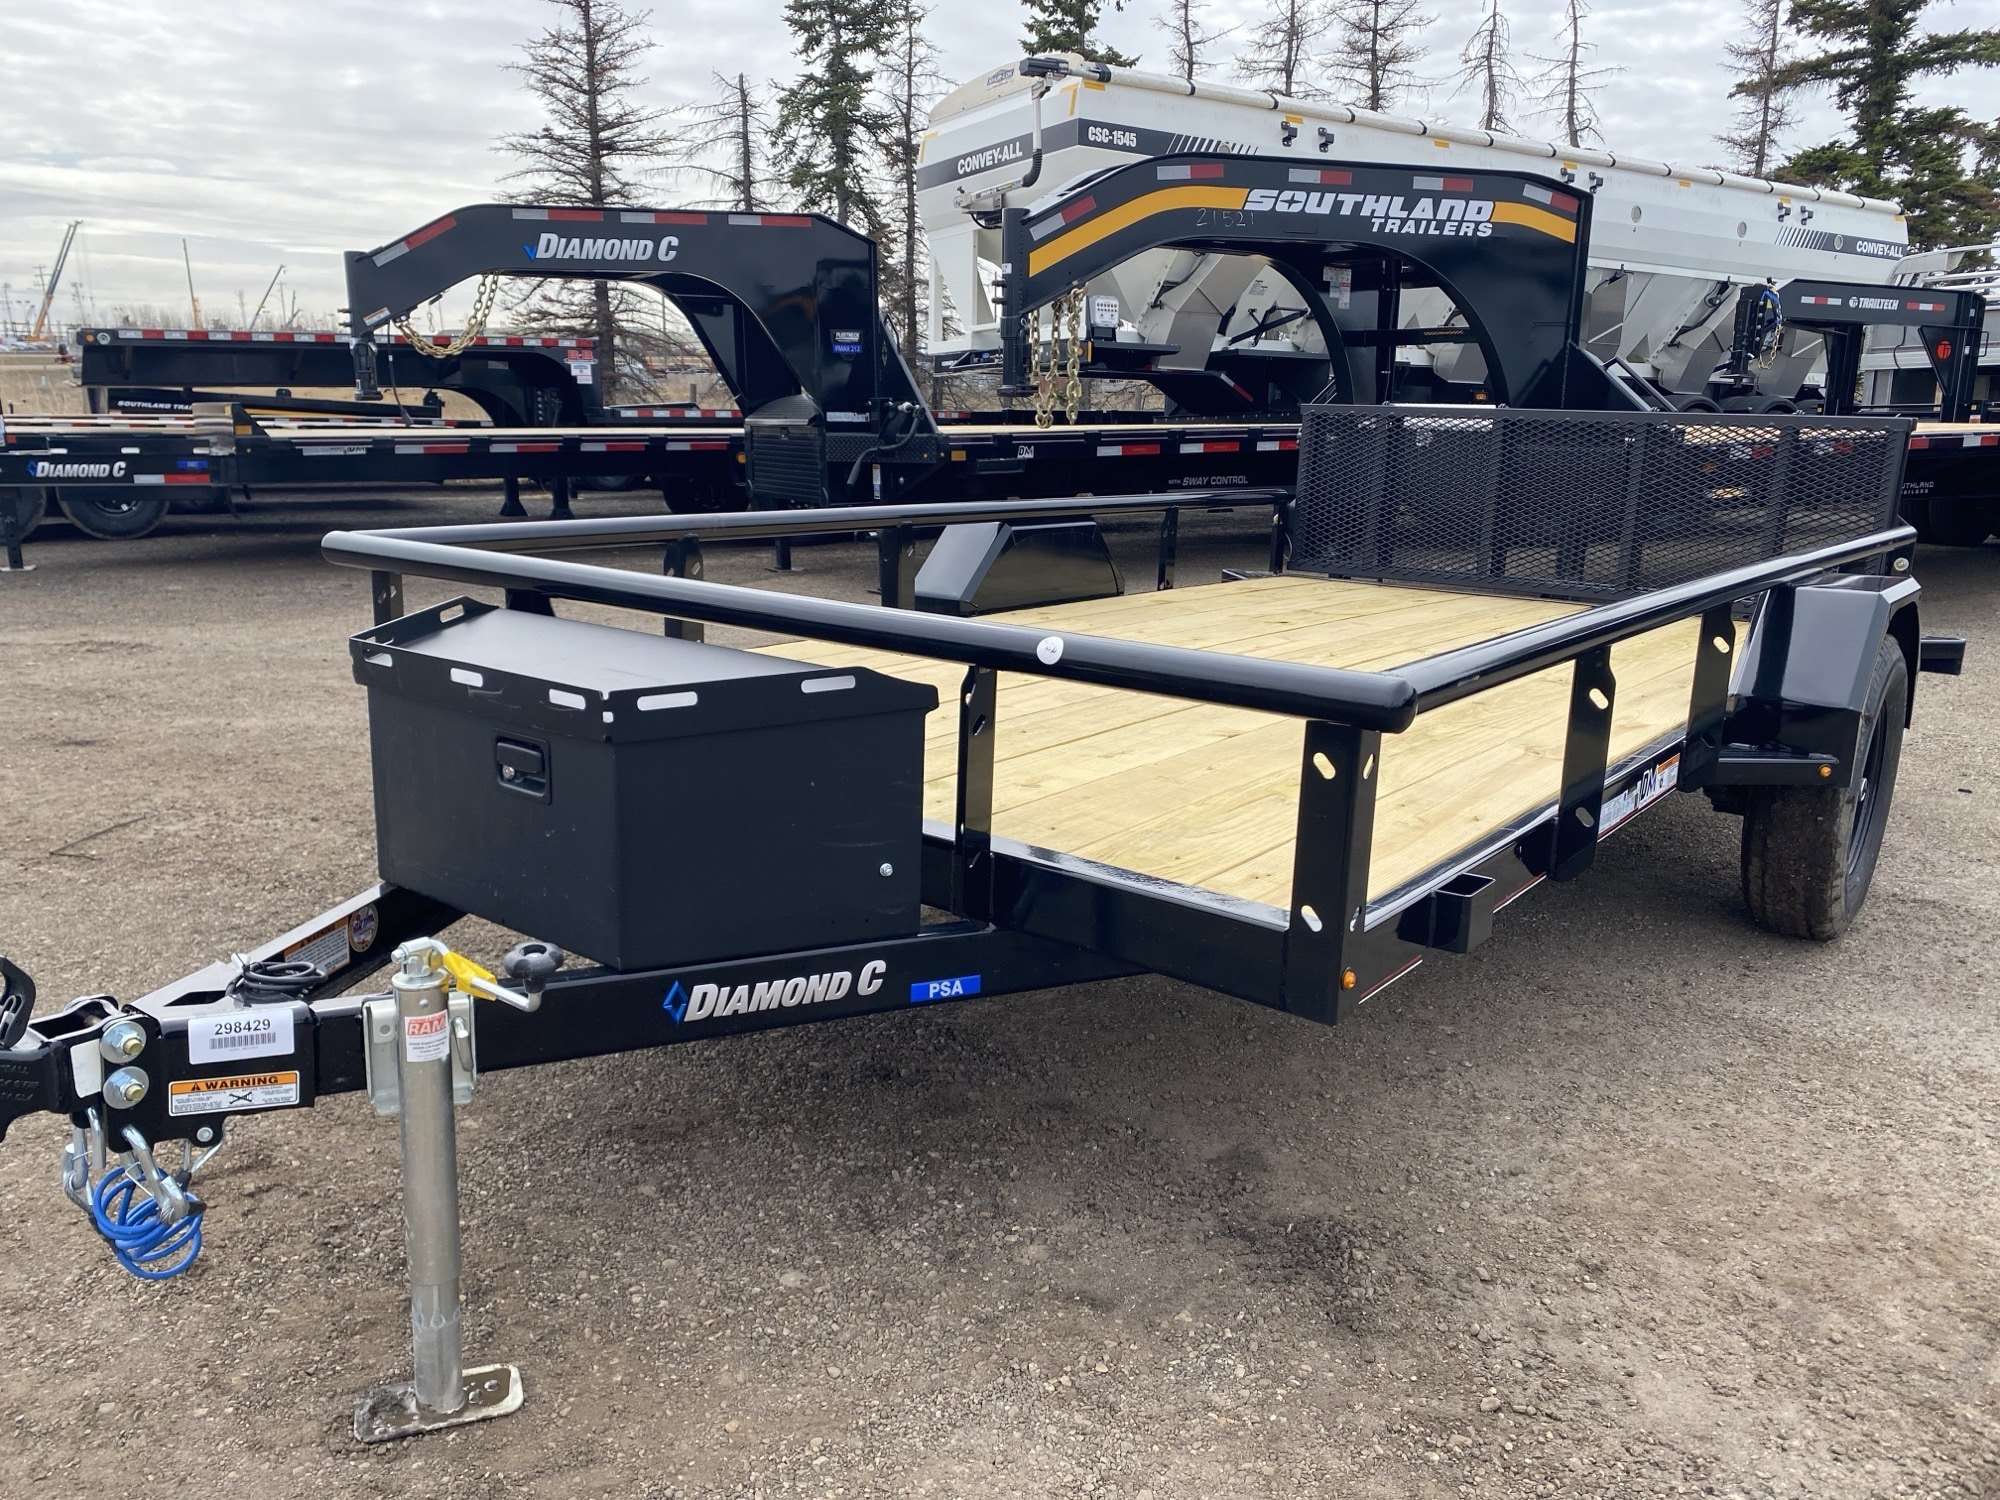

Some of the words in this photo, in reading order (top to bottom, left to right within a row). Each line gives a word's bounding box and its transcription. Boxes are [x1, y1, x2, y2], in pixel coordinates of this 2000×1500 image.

[1088, 126, 1137, 148] CSC-1545
[957, 141, 1023, 175] CONVEY-ALL
[1243, 188, 1496, 222] SOUTHLAND
[1370, 217, 1494, 237] TRAILERS
[536, 233, 654, 261] DIAMOND
[657, 236, 680, 262] C
[1856, 240, 1904, 258] CONVEY-ALL
[1859, 297, 1899, 310] TRAILTECH
[117, 400, 172, 410] SOUTHLAND
[35, 462, 111, 478] DIAMOND
[112, 461, 127, 478] C
[1182, 476, 1209, 487] SWAY
[1210, 475, 1248, 485] CONTROL
[684, 971, 852, 1022] DIAMOND
[857, 960, 886, 996] C
[929, 981, 964, 998] PSA
[214, 1018, 272, 1036] 298429
[408, 1011, 447, 1035] RAM
[205, 1075, 279, 1090] WARNING
